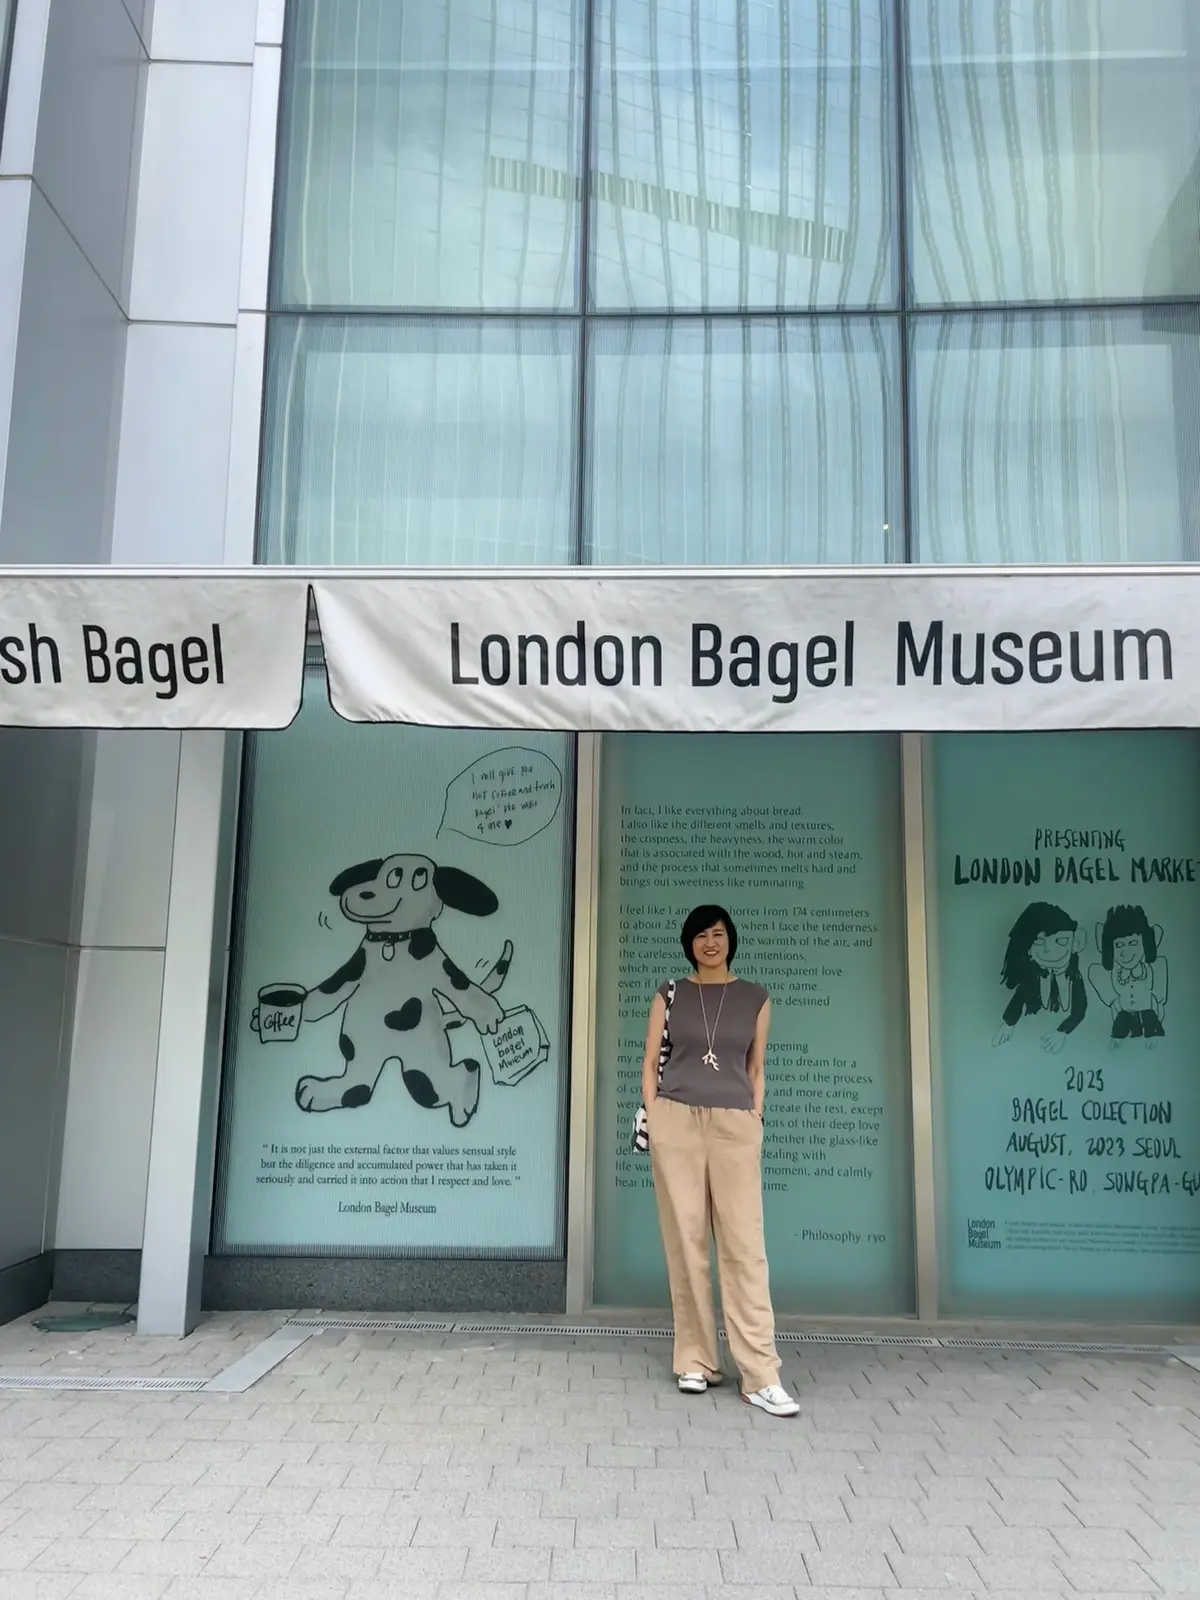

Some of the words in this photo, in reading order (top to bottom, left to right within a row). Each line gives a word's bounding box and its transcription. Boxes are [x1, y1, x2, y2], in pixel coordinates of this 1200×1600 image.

[82, 624, 224, 700] Bagel
[451, 620, 663, 687] London
[690, 621, 854, 704] Bagel
[898, 620, 1173, 687] Museum
[498, 766, 515, 783] give
[621, 805, 631, 815] In
[664, 805, 682, 815] like
[685, 805, 738, 818] everything
[740, 806, 769, 816] about
[627, 820, 648, 829] also
[651, 820, 669, 829] like
[671, 820, 688, 829] the
[690, 820, 731, 830] different
[734, 820, 766, 830] smells
[768, 820, 788, 830] and
[620, 833, 637, 843] the
[691, 834, 707, 844] the
[768, 834, 785, 844] the
[787, 835, 816, 844] warm
[818, 835, 844, 845] color
[1035, 828, 1126, 851] PRESENTING
[620, 848, 639, 857] that
[653, 848, 705, 858] associated
[708, 848, 732, 858] with
[734, 848, 750, 858] the
[787, 849, 804, 858] hot
[806, 849, 826, 859] and
[619, 862, 639, 872] and
[642, 862, 658, 872] the
[661, 864, 698, 874] process
[701, 862, 720, 872] that
[723, 863, 778, 873] sometimes
[781, 864, 809, 873] melts
[812, 864, 834, 873] hard
[837, 864, 856, 874] and
[954, 854, 1041, 886] LONDON
[1054, 855, 1120, 885] BAGEL
[1131, 856, 1200, 884] MARKE
[619, 876, 651, 888] brings
[653, 877, 670, 886] out
[673, 877, 724, 887] sweetness
[727, 877, 745, 887] like
[626, 905, 644, 915] feel
[647, 905, 665, 915] like
[727, 906, 759, 917] horter
[763, 907, 788, 917] from
[793, 907, 807, 917] 174
[810, 908, 870, 917] centimeters
[633, 920, 661, 930] about
[665, 920, 677, 930] 25
[741, 921, 769, 931] when
[779, 922, 799, 932] face
[802, 922, 819, 932] the
[822, 923, 878, 933] tenderness
[632, 934, 648, 944] the
[757, 936, 796, 946] warmth
[813, 937, 830, 947] the
[853, 938, 873, 948] and
[619, 949, 635, 959] the
[619, 964, 648, 974] which
[651, 966, 667, 974] are
[734, 966, 757, 976] with
[760, 966, 818, 977] transparent
[822, 967, 843, 977] love
[624, 994, 640, 1003] am
[785, 996, 830, 1007] destined
[263, 1011, 295, 1032] Coffee
[493, 1025, 524, 1048] London
[497, 1037, 525, 1058] bagel
[766, 1043, 809, 1053] opening
[617, 1055, 632, 1064] my
[782, 1057, 793, 1066] to
[796, 1057, 830, 1067] dream
[833, 1058, 847, 1068] for
[813, 1072, 830, 1083] the
[833, 1075, 873, 1085] process
[1064, 1066, 1104, 1092] 2023
[773, 1087, 793, 1097] and
[796, 1089, 823, 1098] more
[826, 1090, 859, 1101] caring
[616, 1101, 640, 1110] were
[769, 1104, 801, 1113] create
[804, 1103, 821, 1113] the
[850, 1105, 883, 1117] except
[1012, 1098, 1068, 1124] BAGEL
[1081, 1100, 1172, 1125] COLECTION
[616, 1115, 630, 1124] for
[801, 1118, 826, 1129] their
[829, 1119, 855, 1132] deep
[858, 1120, 880, 1130] love
[616, 1130, 630, 1140] for
[763, 1132, 805, 1144] whether
[809, 1134, 826, 1145] the
[291, 1145, 306, 1154] not
[308, 1144, 325, 1156] just
[327, 1144, 341, 1154] the
[344, 1144, 380, 1155] external
[383, 1144, 410, 1155] factor
[412, 1145, 429, 1155] that
[432, 1145, 460, 1156] values
[462, 1146, 494, 1156] sensual
[496, 1146, 516, 1159] style
[802, 1150, 826, 1160] with
[1085, 1137, 1125, 1158] 2023
[1132, 1137, 1182, 1159] SEOUL
[260, 1158, 276, 1169] but
[279, 1159, 293, 1169] the
[295, 1159, 335, 1172] diligence
[337, 1159, 354, 1169] and
[357, 1160, 413, 1170] accumulated
[415, 1162, 444, 1173] power
[446, 1160, 464, 1171] that
[466, 1160, 482, 1171] has
[484, 1161, 508, 1171] taken
[615, 1161, 631, 1171] life
[814, 1166, 834, 1177] and
[837, 1167, 873, 1179] calmly
[256, 1174, 295, 1187] seriously
[298, 1174, 315, 1184] and
[317, 1174, 348, 1185] carried
[360, 1175, 378, 1185] into
[380, 1175, 408, 1185] action
[411, 1175, 428, 1185] that
[438, 1175, 470, 1188] respect
[472, 1176, 489, 1186] and
[615, 1176, 637, 1187] hear
[338, 1201, 372, 1213] London
[374, 1201, 398, 1217] Bagel
[400, 1202, 437, 1214] Museum
[967, 1218, 996, 1229] London
[968, 1228, 989, 1239] Bagel
[968, 1238, 1001, 1250] Museum
